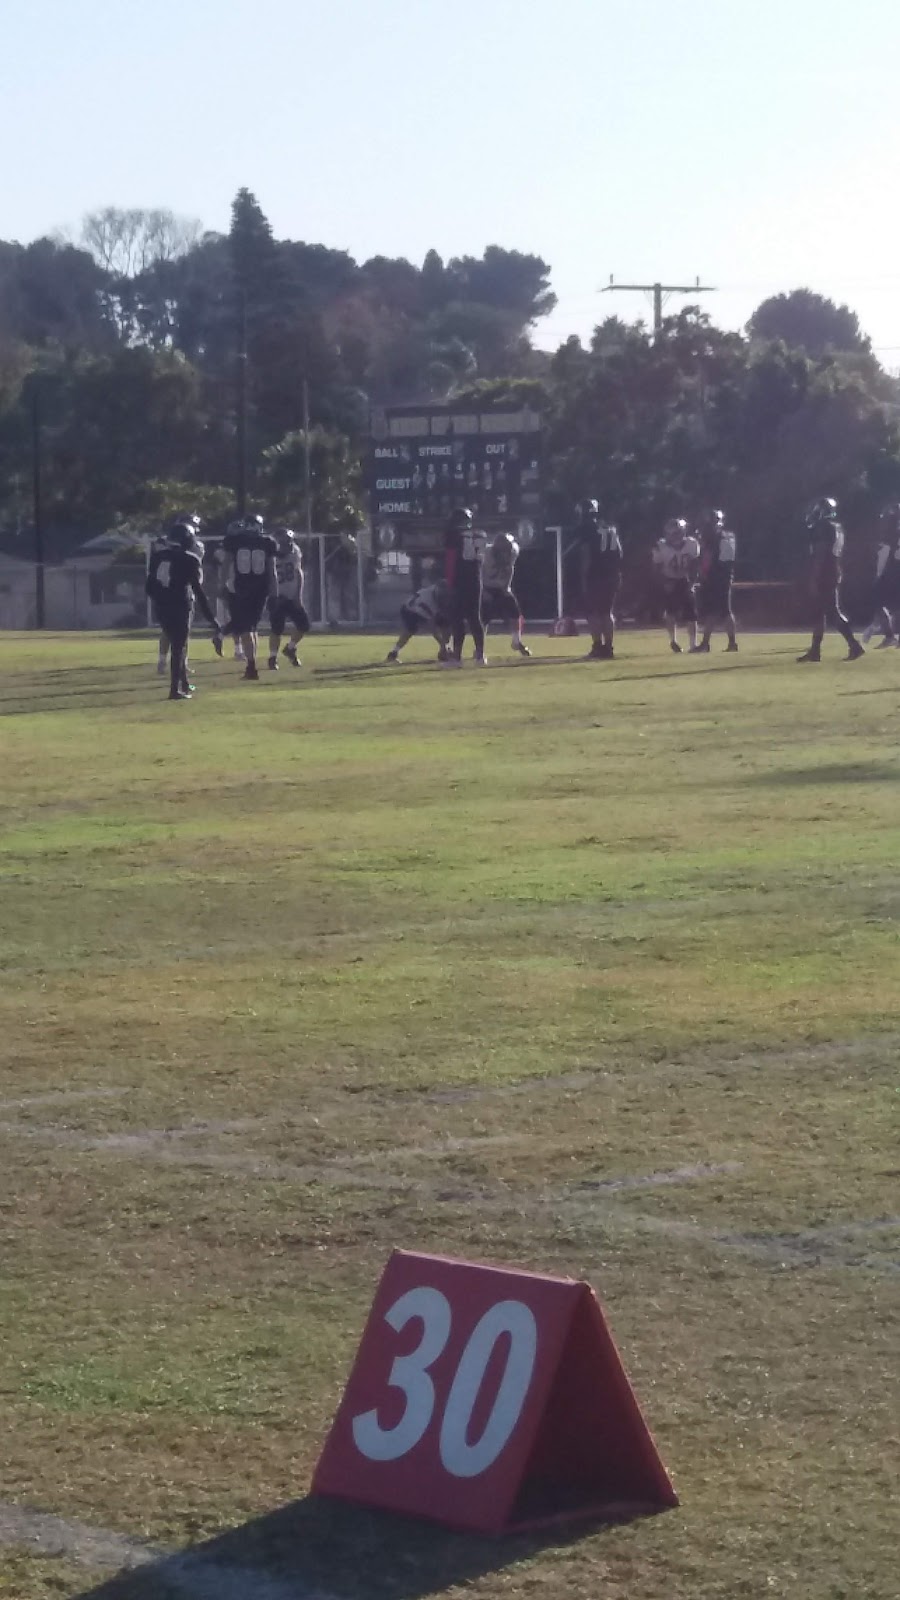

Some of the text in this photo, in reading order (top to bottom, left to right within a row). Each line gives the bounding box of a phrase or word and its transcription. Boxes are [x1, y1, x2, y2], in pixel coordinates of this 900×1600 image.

[374, 444, 505, 458] BALL STRIKE OUT
[376, 478, 410, 489] GUEST
[379, 502, 410, 513] HOME
[352, 1286, 537, 1477] 30
